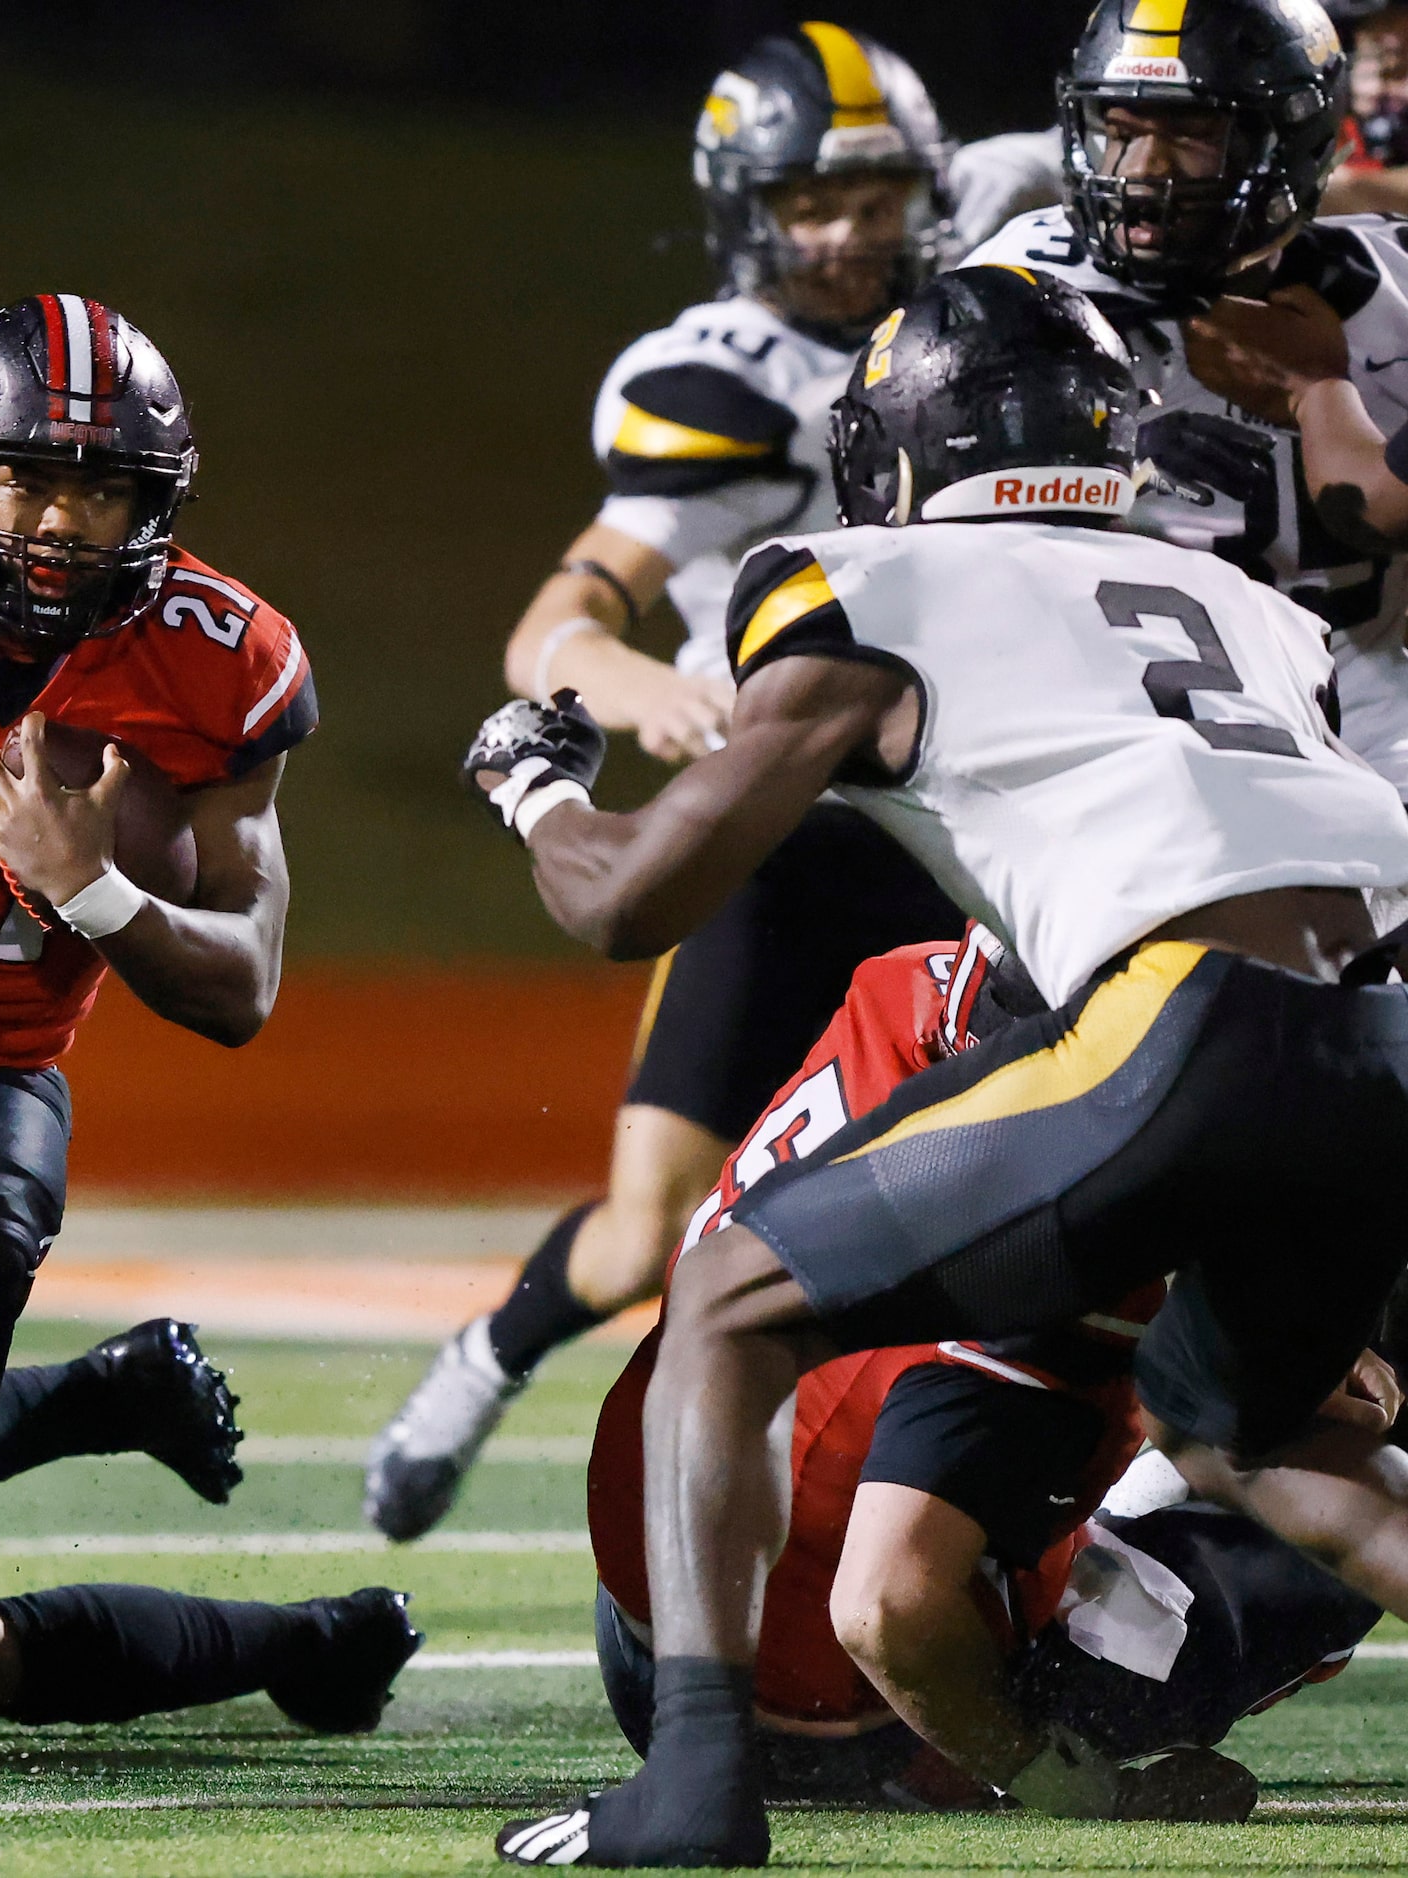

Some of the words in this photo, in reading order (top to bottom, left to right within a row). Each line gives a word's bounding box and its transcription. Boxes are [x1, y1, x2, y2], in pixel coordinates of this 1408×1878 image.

[863, 307, 906, 389] 2
[994, 476, 1121, 505] Riddell
[159, 568, 260, 652] 21
[1095, 579, 1311, 761] 2
